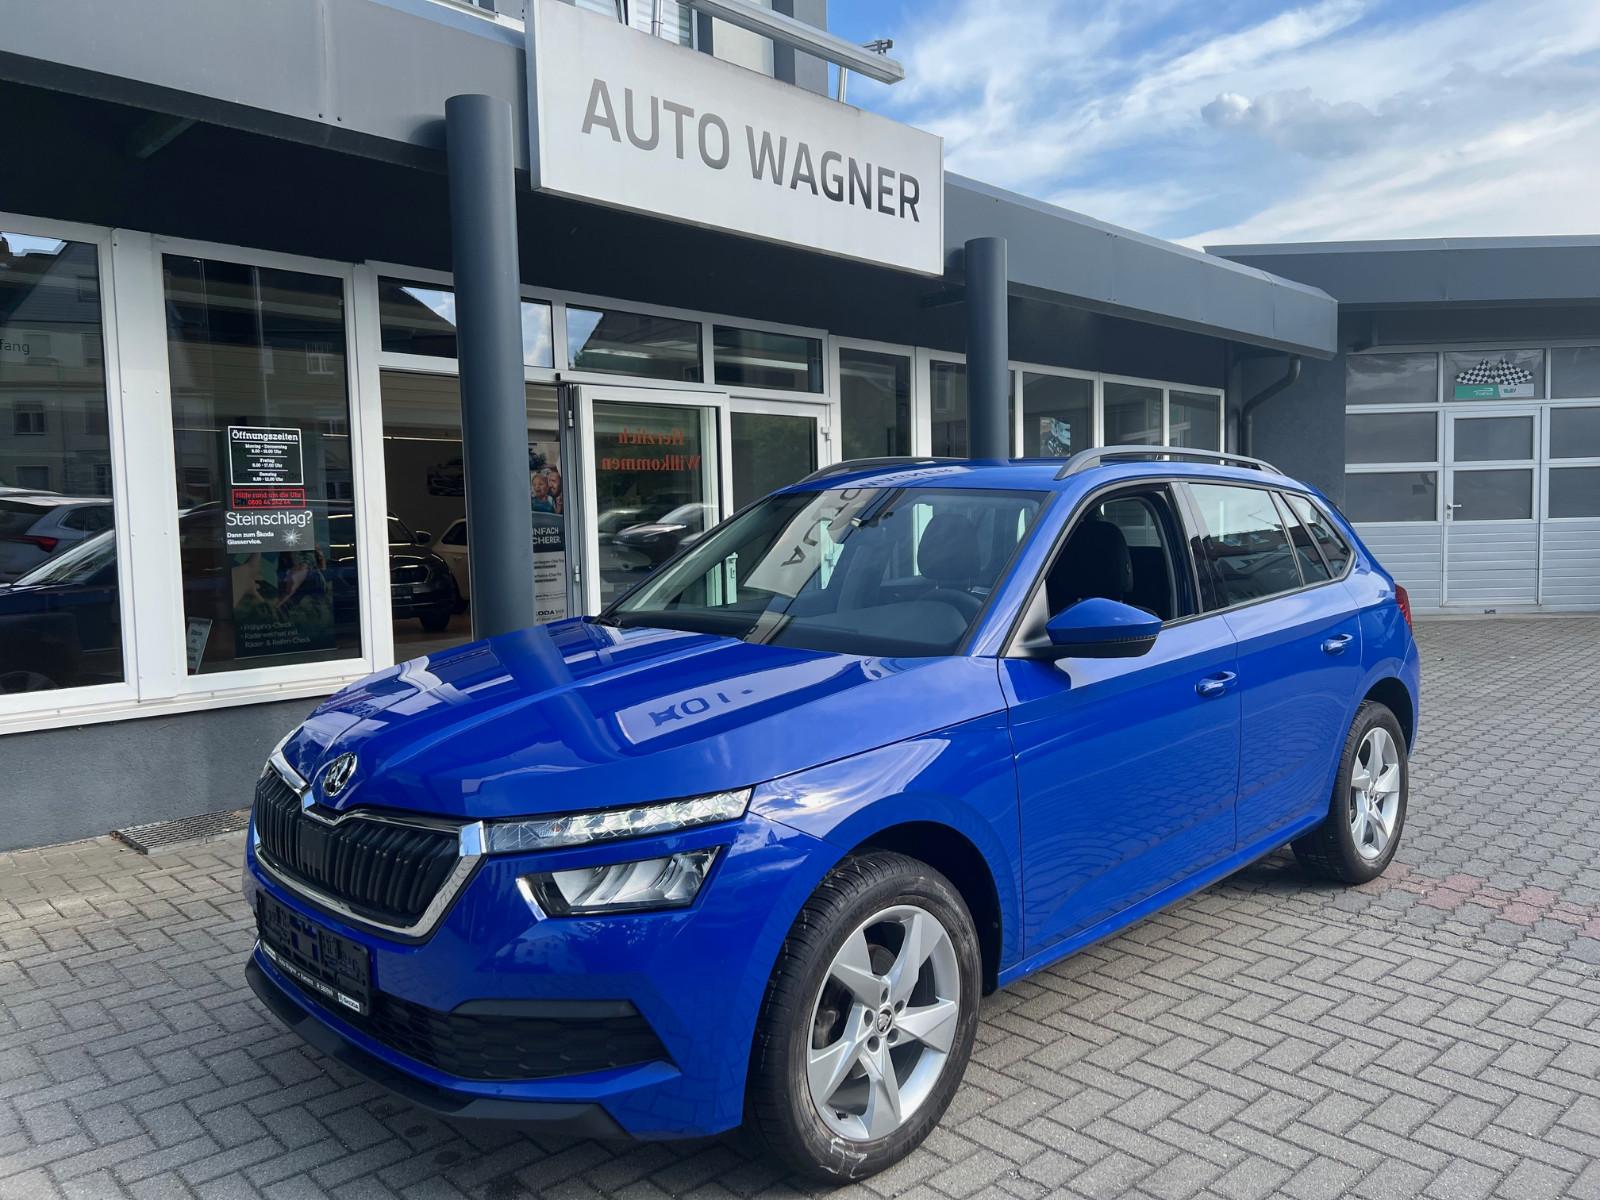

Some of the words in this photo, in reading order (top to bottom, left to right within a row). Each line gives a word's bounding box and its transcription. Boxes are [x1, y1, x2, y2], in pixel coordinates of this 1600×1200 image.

[581, 78, 730, 171] AUTO
[745, 124, 921, 223] WAGNER
[232, 429, 299, 441] Öffnungszeiten
[226, 510, 313, 528] Steinschlag?
